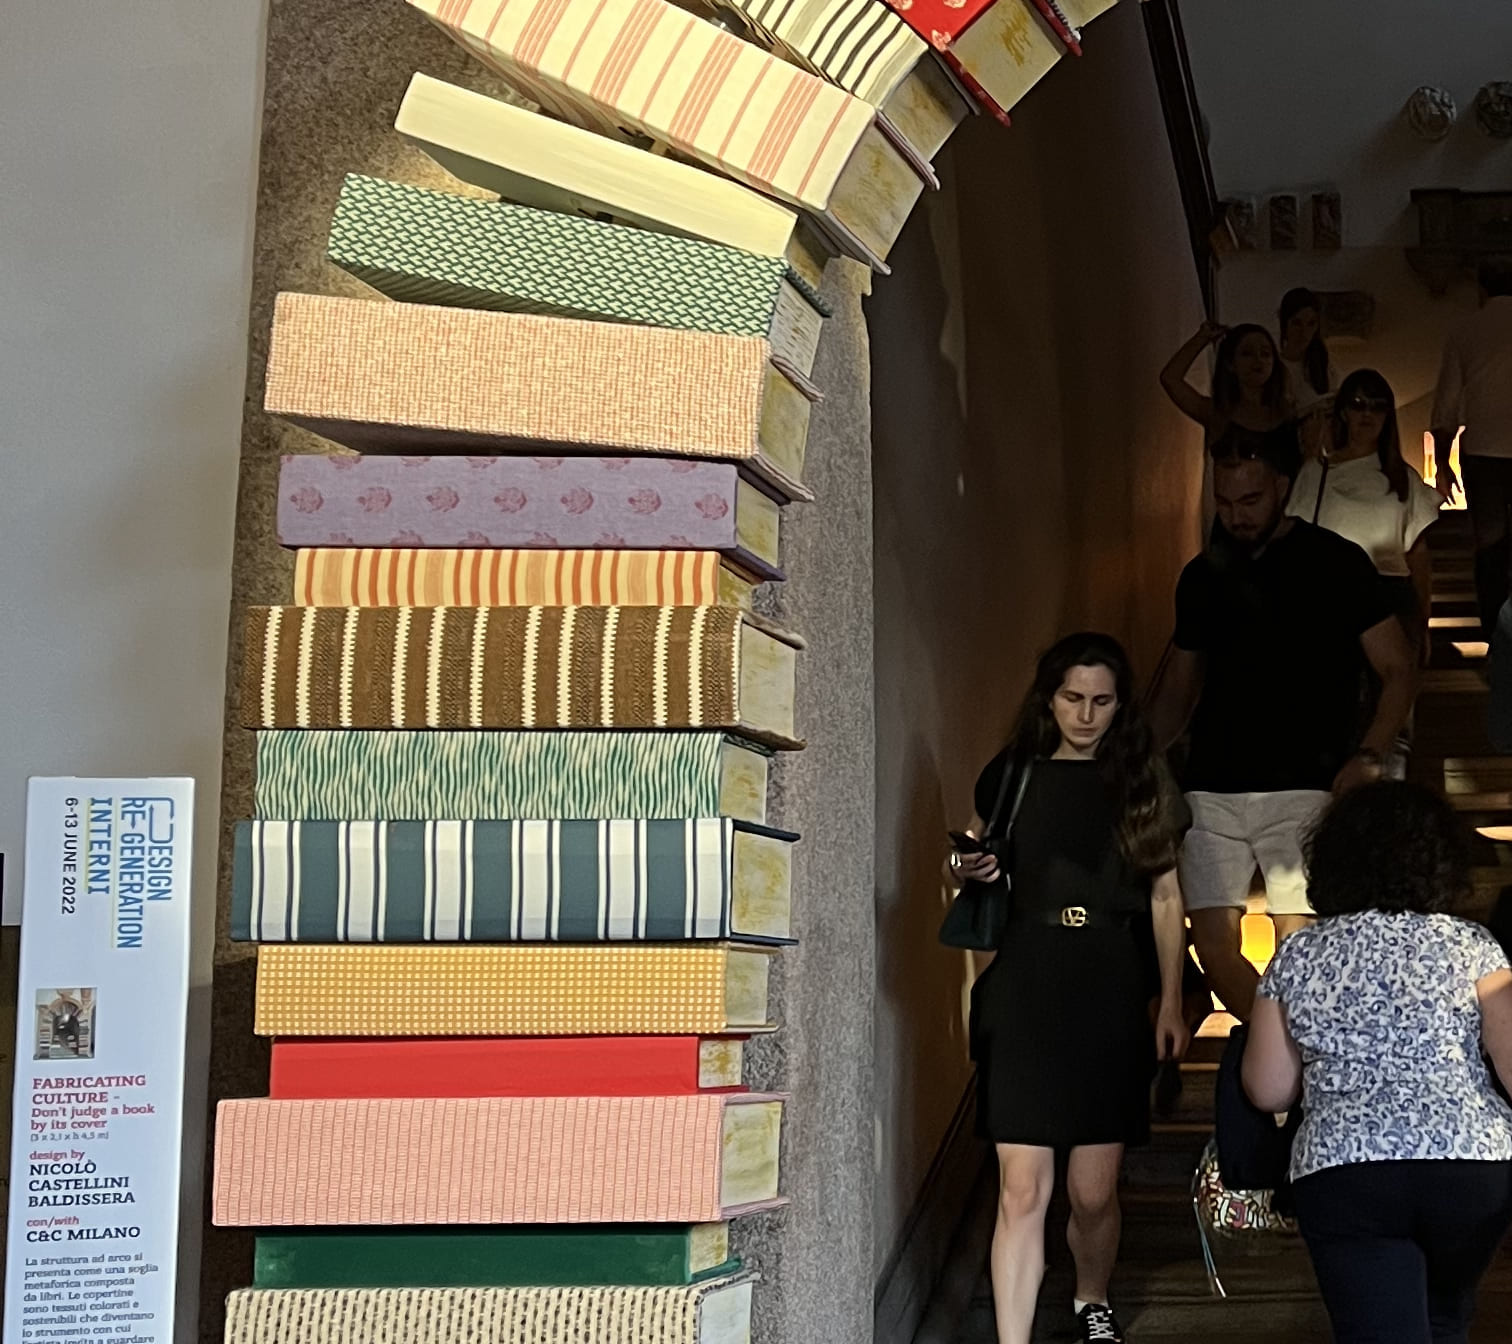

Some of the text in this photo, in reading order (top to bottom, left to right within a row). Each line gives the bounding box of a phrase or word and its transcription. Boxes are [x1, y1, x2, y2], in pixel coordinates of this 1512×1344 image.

[88, 797, 112, 895] INTERNI
[147, 804, 174, 901] DESIGN
[61, 797, 79, 915] 6-13 JUNE 2022
[33, 1075, 146, 1089] FABRICATING
[32, 1092, 109, 1104] CULTURE
[32, 1104, 155, 1119] Don't judge a book
[31, 1119, 107, 1132] by its cover
[30, 1149, 85, 1161] design by
[30, 1159, 96, 1175] NICOLÒ
[29, 1177, 129, 1191] CASTELLINI
[28, 1192, 135, 1207] BALDISSERA
[27, 1216, 79, 1228] con/with
[26, 1227, 140, 1242] C&C MILANO
[25, 1253, 143, 1266] La struttura ad arco si
[24, 1264, 159, 1280] presenta come una soglia
[24, 1277, 135, 1290] metaforica composta
[23, 1293, 37, 1302] da
[68, 1291, 81, 1299] Le
[83, 1289, 134, 1300] copertine
[23, 1306, 49, 1314] sono
[52, 1302, 87, 1312] tessuti
[89, 1300, 130, 1310] colorati
[22, 1312, 154, 1326] sostenibili che diventano
[22, 1324, 131, 1338] lo strumento con cui
